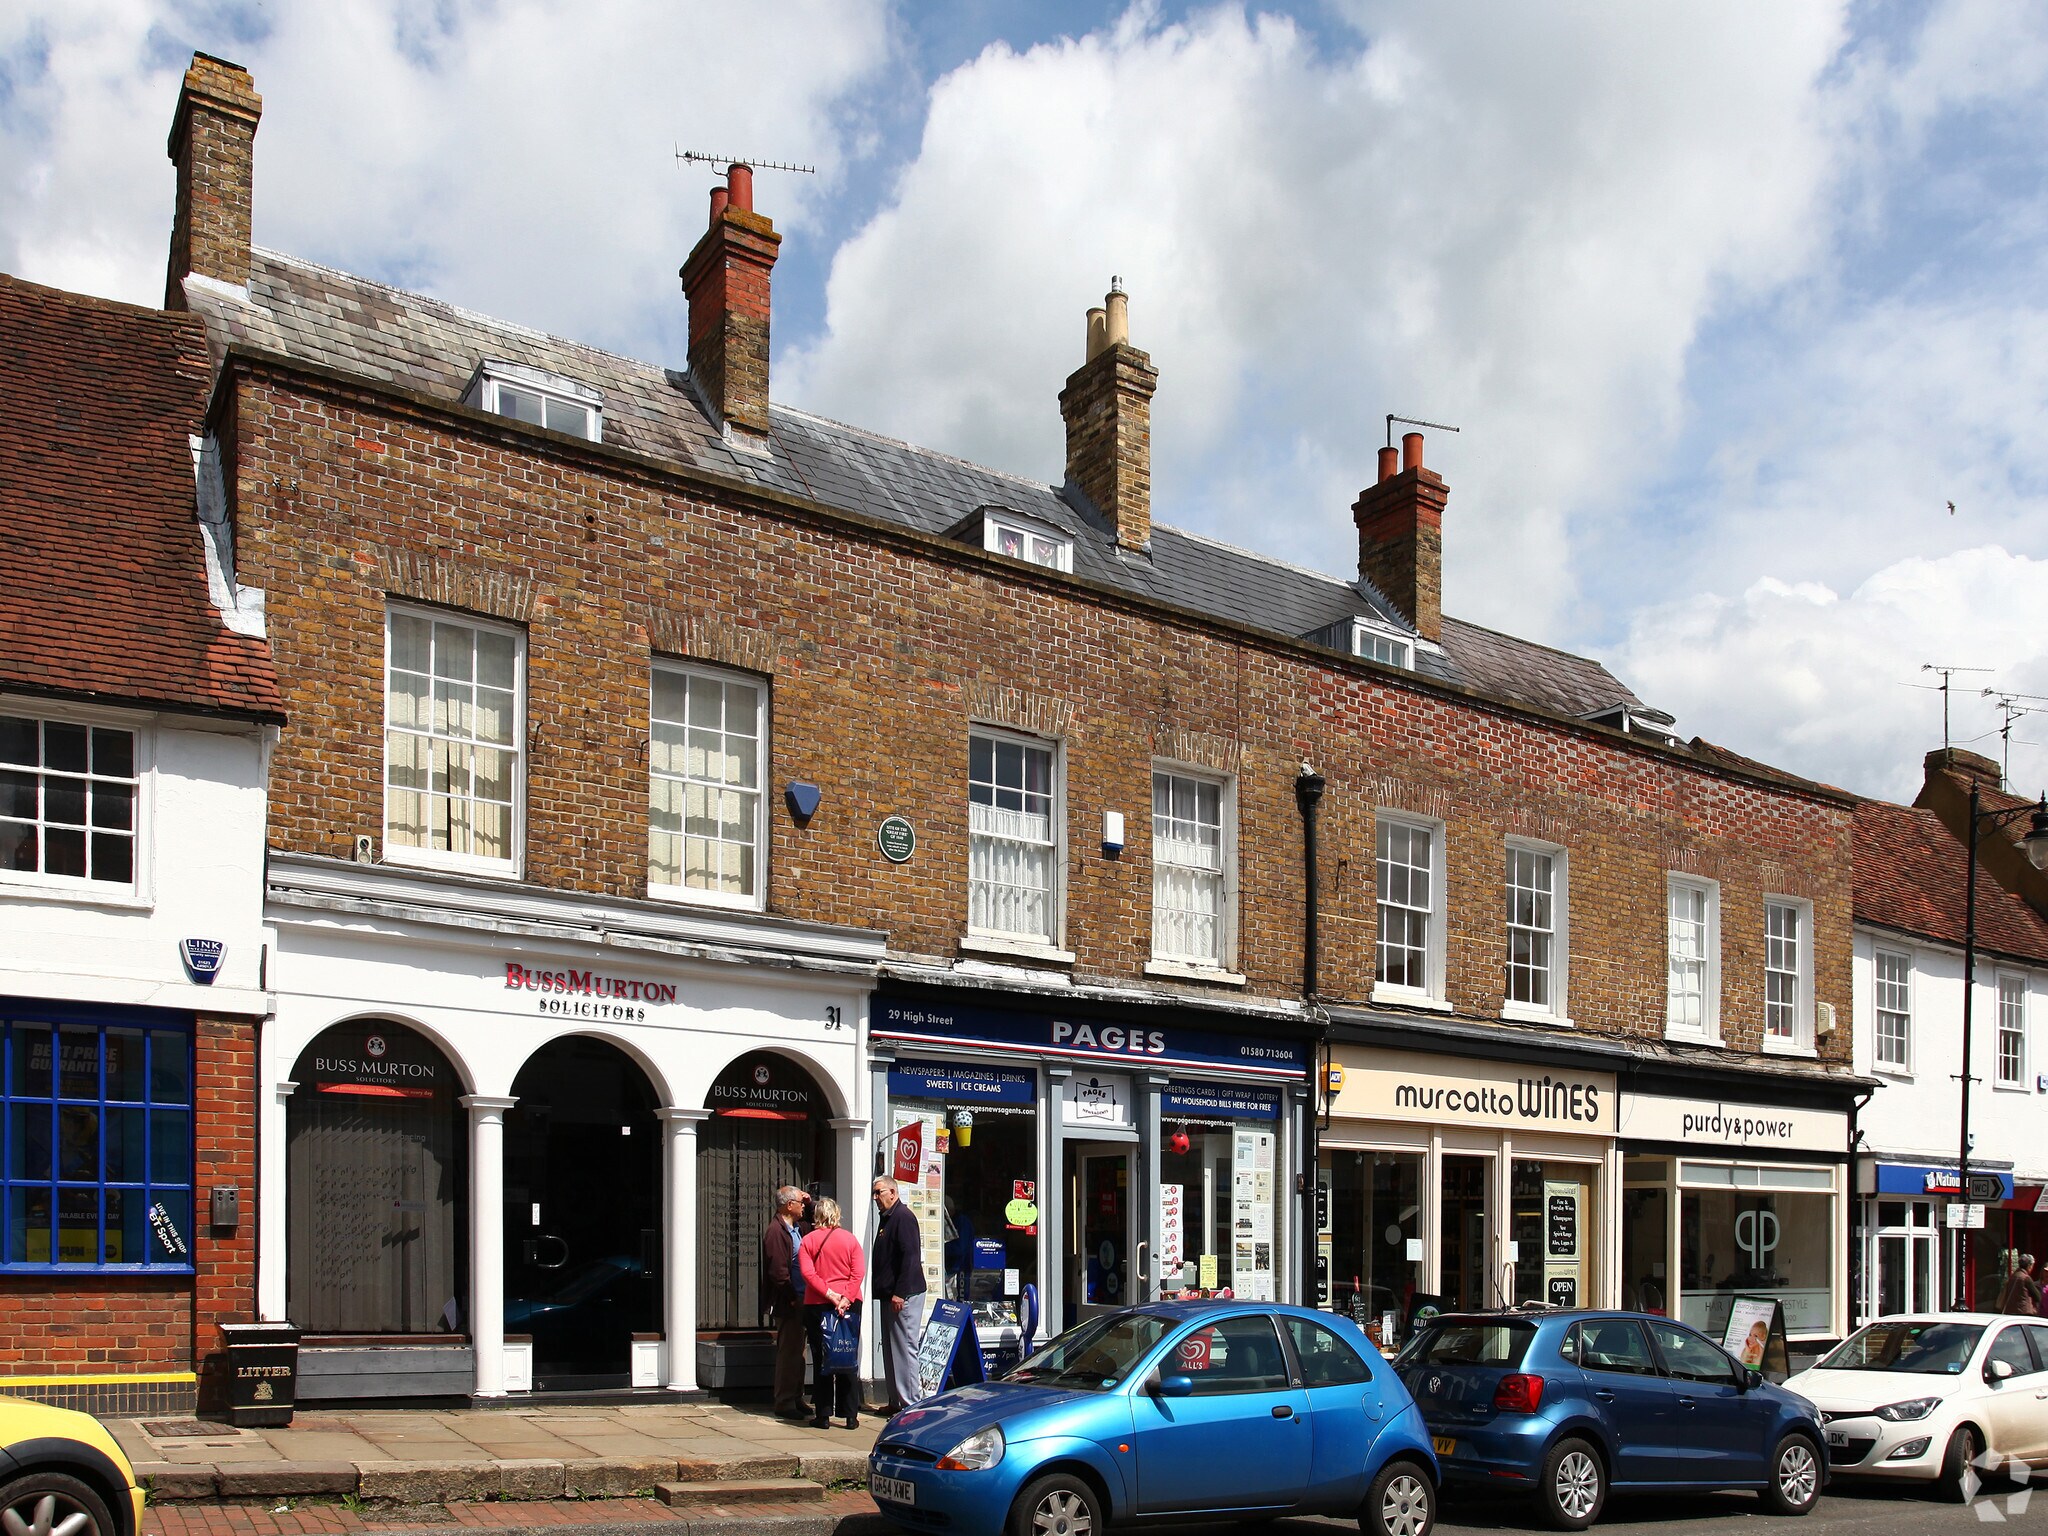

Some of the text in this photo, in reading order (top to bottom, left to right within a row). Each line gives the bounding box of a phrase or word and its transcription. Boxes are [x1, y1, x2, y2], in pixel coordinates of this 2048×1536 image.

[188, 939, 220, 950] LINK
[540, 998, 645, 1020] SOLICITORS
[824, 1006, 841, 1030] 31
[888, 1009, 954, 1026] 29 High Street
[1053, 1021, 1166, 1054] PAGES
[32, 1043, 71, 1058] BET
[1240, 1046, 1293, 1060] 01580 713604
[315, 1057, 434, 1078] BUSS MURTON
[900, 1066, 1026, 1083] NEWSPAPERS MAGAZINES DRINKS
[355, 1076, 396, 1084] SOLICITORS
[926, 1079, 1002, 1093] SWEETS ICE CREAMS
[714, 1085, 808, 1103] BUSS MURTON
[1082, 1089, 1106, 1098] PAGES
[1163, 1085, 1279, 1102] GREETINGS CARDS GIFT WRAP LOTTERY
[745, 1101, 778, 1109] SOLICITORS
[946, 1103, 1036, 1116] www.pagesnewsagents.com
[1171, 1096, 1272, 1112] PAY HOUSEHOLD BILLS HERE FOR FREE
[1161, 1115, 1236, 1128] www.pagesnewsagents.com
[899, 1161, 916, 1171] WALL'S
[1974, 1184, 1987, 1193] WC
[149, 1212, 176, 1254] BT Sport
[155, 1202, 187, 1254] LIVE IN THIS SHOP
[1551, 1281, 1574, 1292] OPEN
[1560, 1296, 1566, 1307] 7
[1705, 1301, 1723, 1312] HAIR
[238, 1366, 292, 1378] LITTER
